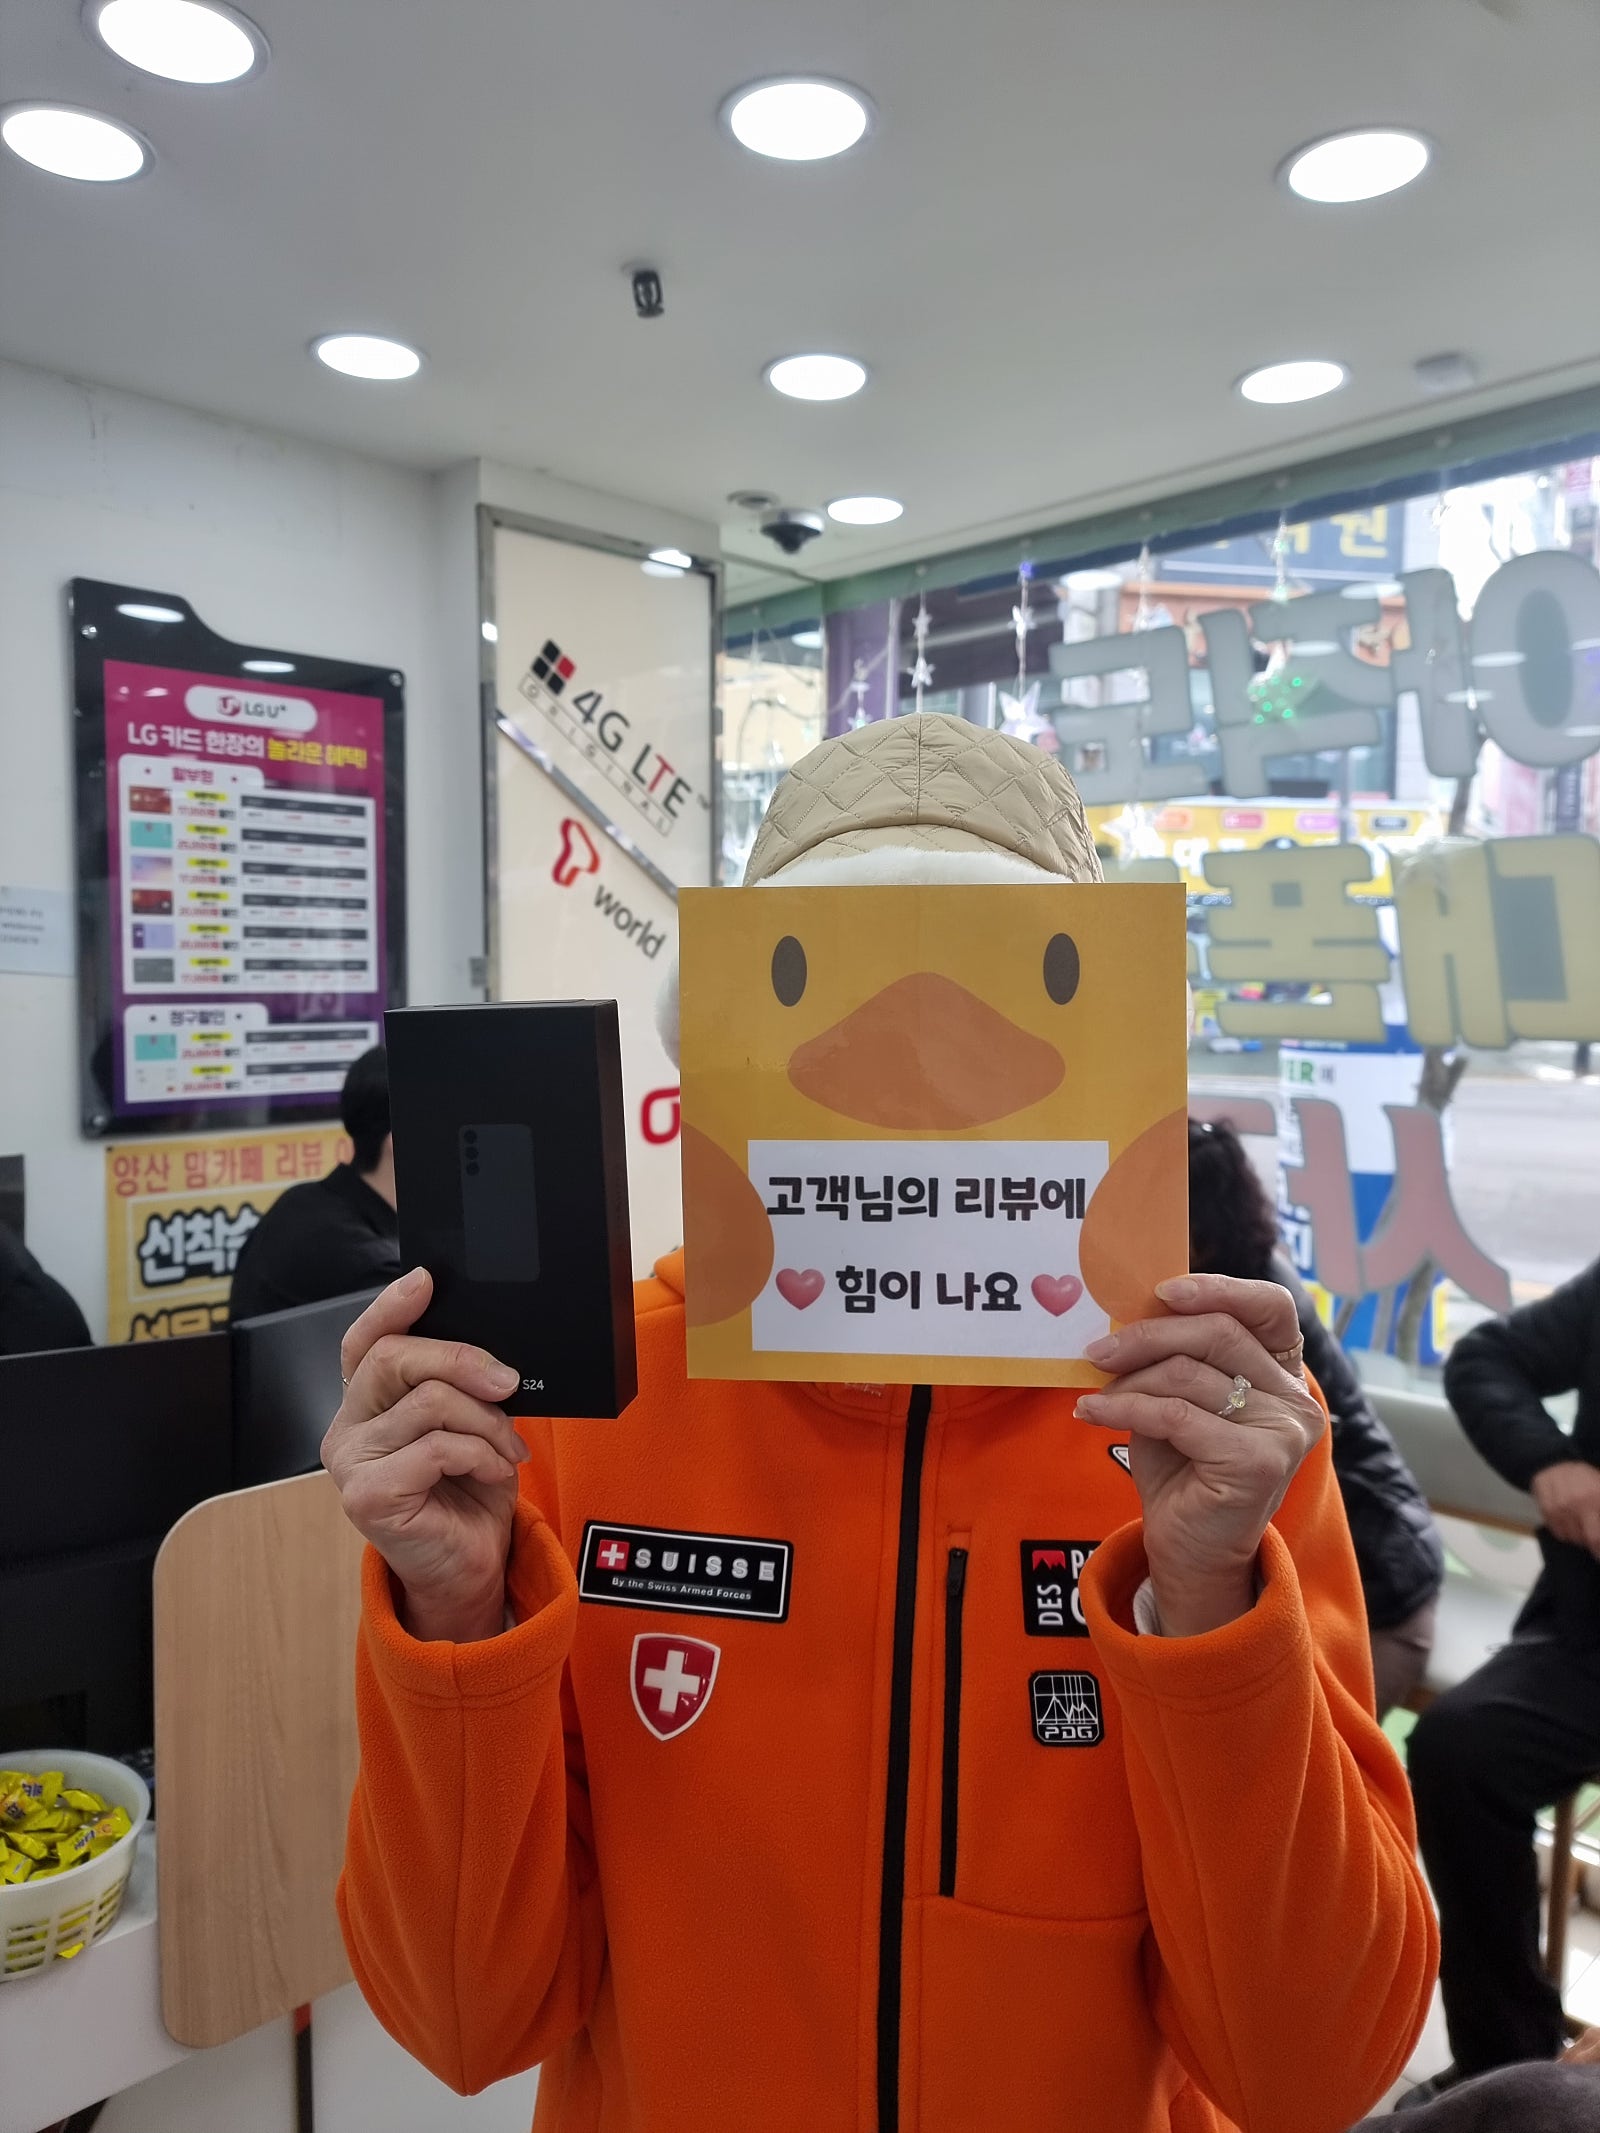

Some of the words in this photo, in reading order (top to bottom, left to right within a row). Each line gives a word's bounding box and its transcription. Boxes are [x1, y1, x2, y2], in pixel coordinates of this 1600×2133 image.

[127, 721, 158, 746] LG
[572, 690, 631, 753] 4G
[631, 743, 693, 819] LTE
[594, 883, 667, 960] world
[113, 1154, 170, 1198] 양산
[275, 1141, 322, 1177] 리뷰
[766, 1174, 940, 1223] 고객님의
[953, 1175, 1086, 1222] 리뷰에
[835, 1264, 921, 1314] 힘이
[935, 1270, 1022, 1312] 나요
[522, 1379, 545, 1391] S24
[634, 1547, 776, 1582] SUISSE
[611, 1576, 624, 1587] By
[628, 1580, 644, 1590] the
[647, 1581, 677, 1593] Swiss
[680, 1585, 713, 1597] Armed
[716, 1589, 752, 1600] Forces
[1037, 1584, 1064, 1626] DES
[1044, 1726, 1093, 1739] PDG
